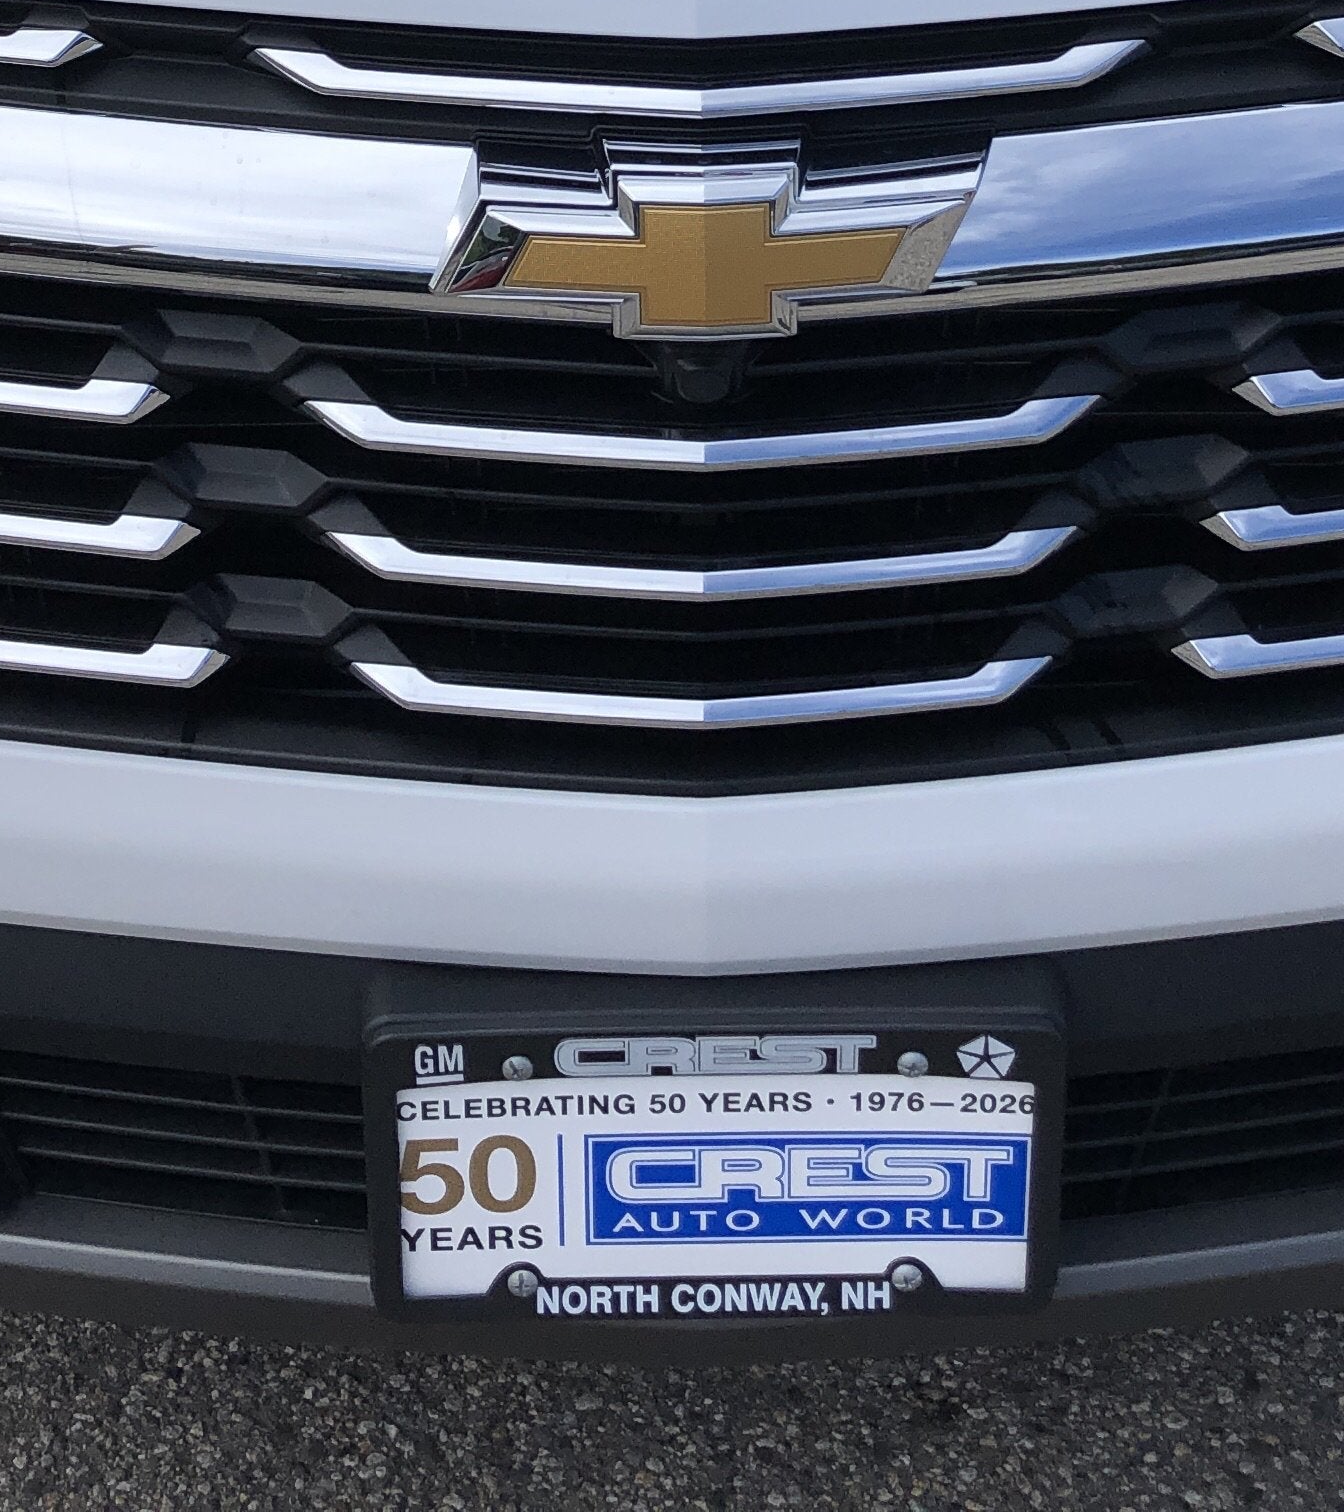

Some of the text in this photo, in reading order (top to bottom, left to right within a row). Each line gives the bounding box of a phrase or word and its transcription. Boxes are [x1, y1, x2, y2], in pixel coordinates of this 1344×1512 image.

[414, 1043, 464, 1076] GM
[554, 1035, 877, 1077] CREST
[397, 1094, 636, 1122] CELEBRATING
[648, 1093, 686, 1114] 50
[698, 1091, 813, 1113] YEARS
[399, 1134, 537, 1216] 50
[605, 1144, 1014, 1205] CREST
[612, 1208, 1004, 1233] AUTO WORLD
[401, 1224, 544, 1252] YEARS
[536, 1281, 892, 1316] NORTH CONWAY, NH
